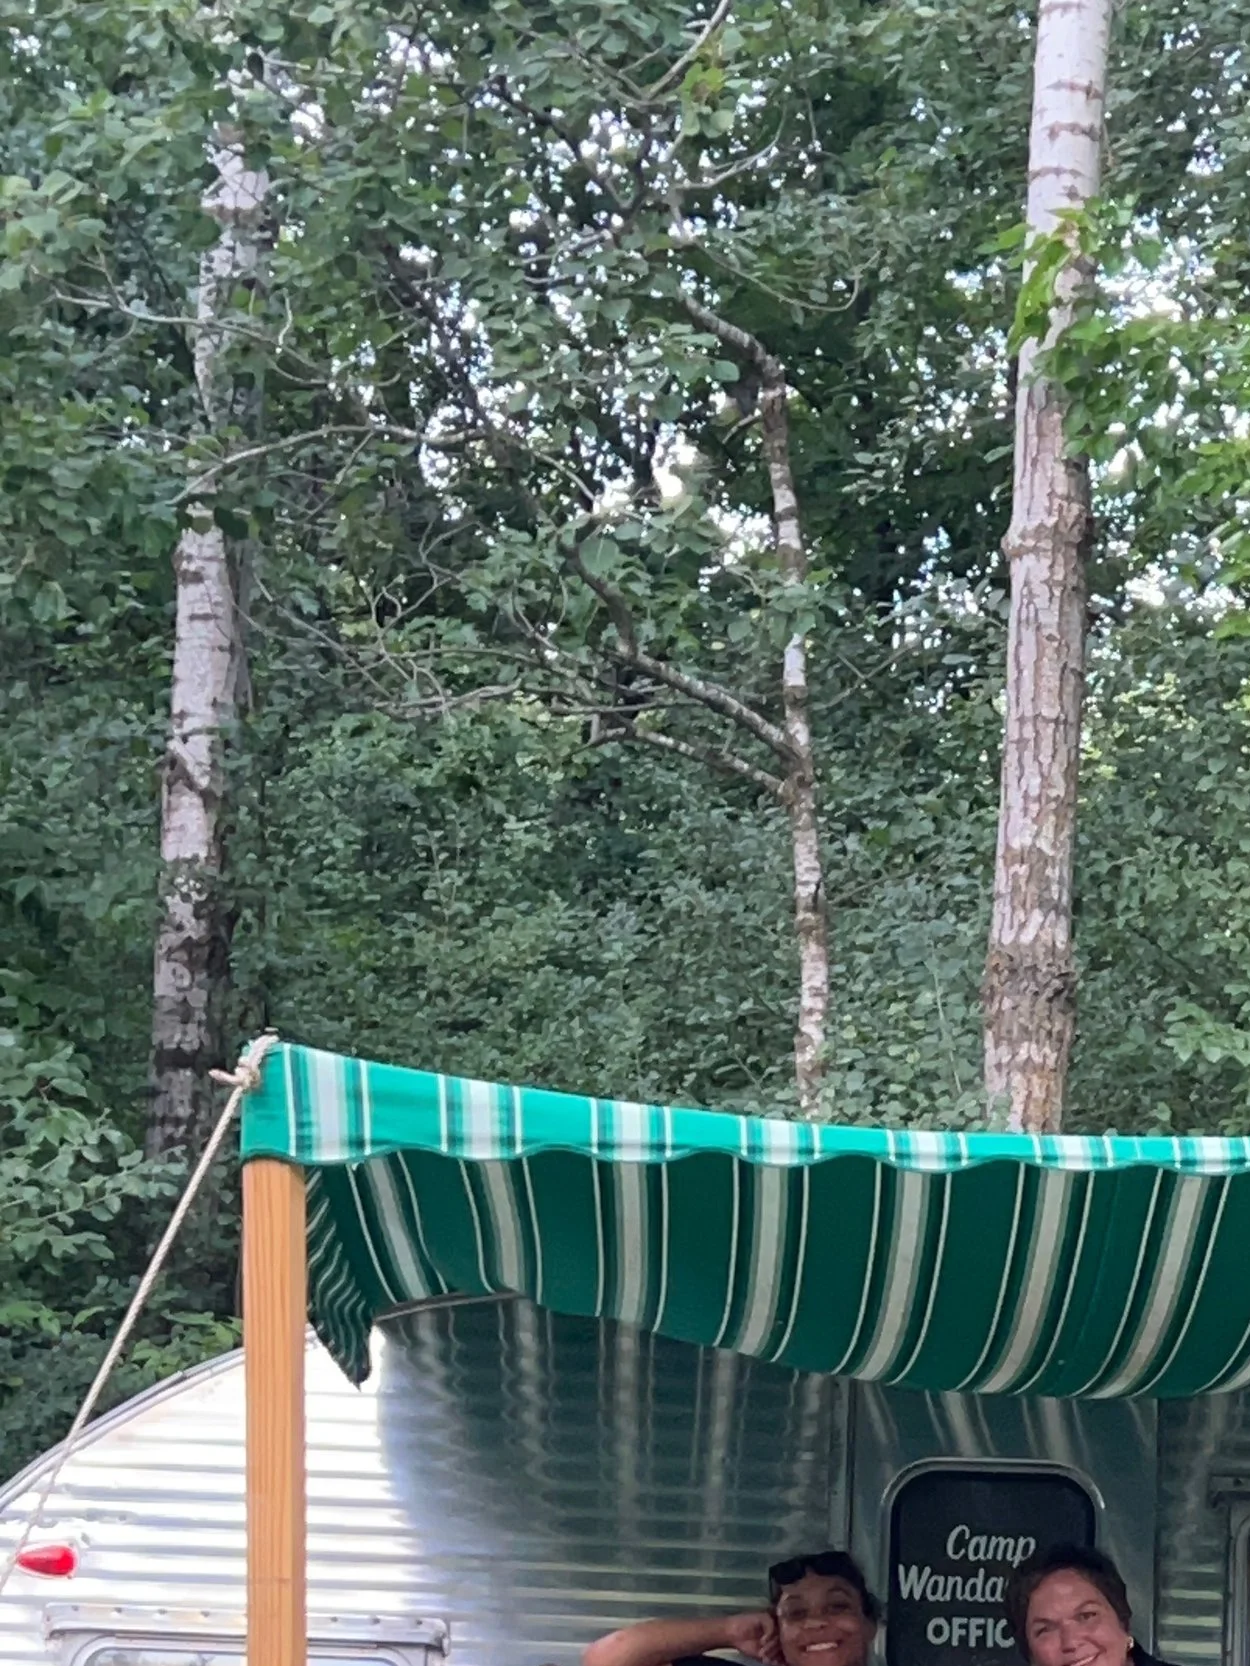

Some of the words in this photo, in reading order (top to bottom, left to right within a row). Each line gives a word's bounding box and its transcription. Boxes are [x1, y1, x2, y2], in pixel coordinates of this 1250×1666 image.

[946, 1524, 1036, 1569] Camp
[897, 1563, 1009, 1603] Wanda
[926, 1616, 1016, 1649] OFFIC
